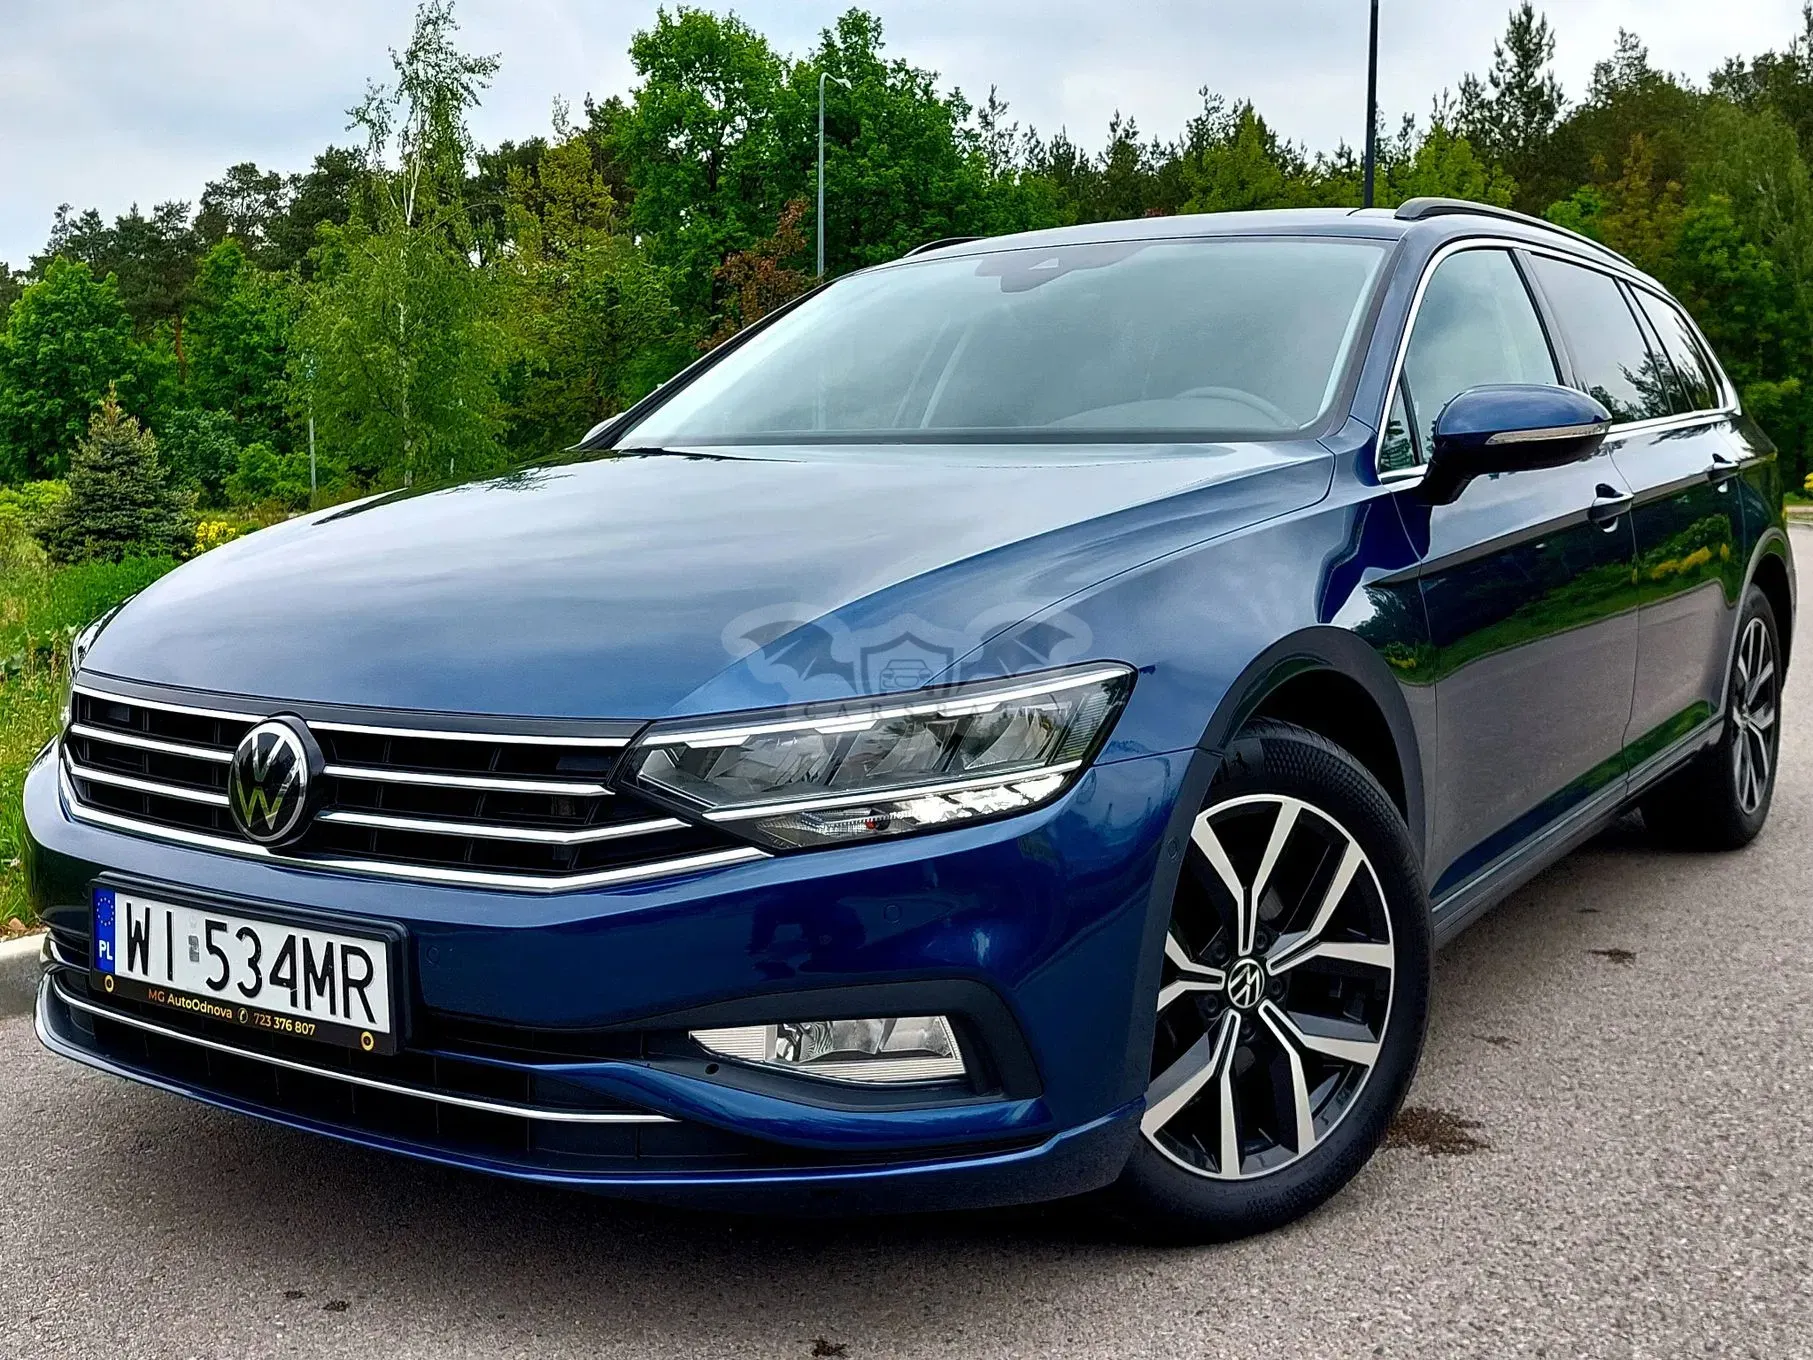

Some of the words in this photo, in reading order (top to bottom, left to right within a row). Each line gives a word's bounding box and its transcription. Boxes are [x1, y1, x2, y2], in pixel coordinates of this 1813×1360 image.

[98, 939, 114, 961] PL
[126, 902, 174, 982] WI
[204, 918, 377, 1025] 534MR
[148, 988, 165, 1002] MG
[167, 993, 233, 1019] AutoOdnova
[253, 1012, 272, 1027] 723
[273, 1016, 293, 1031] 376
[294, 1020, 316, 1036] 807
